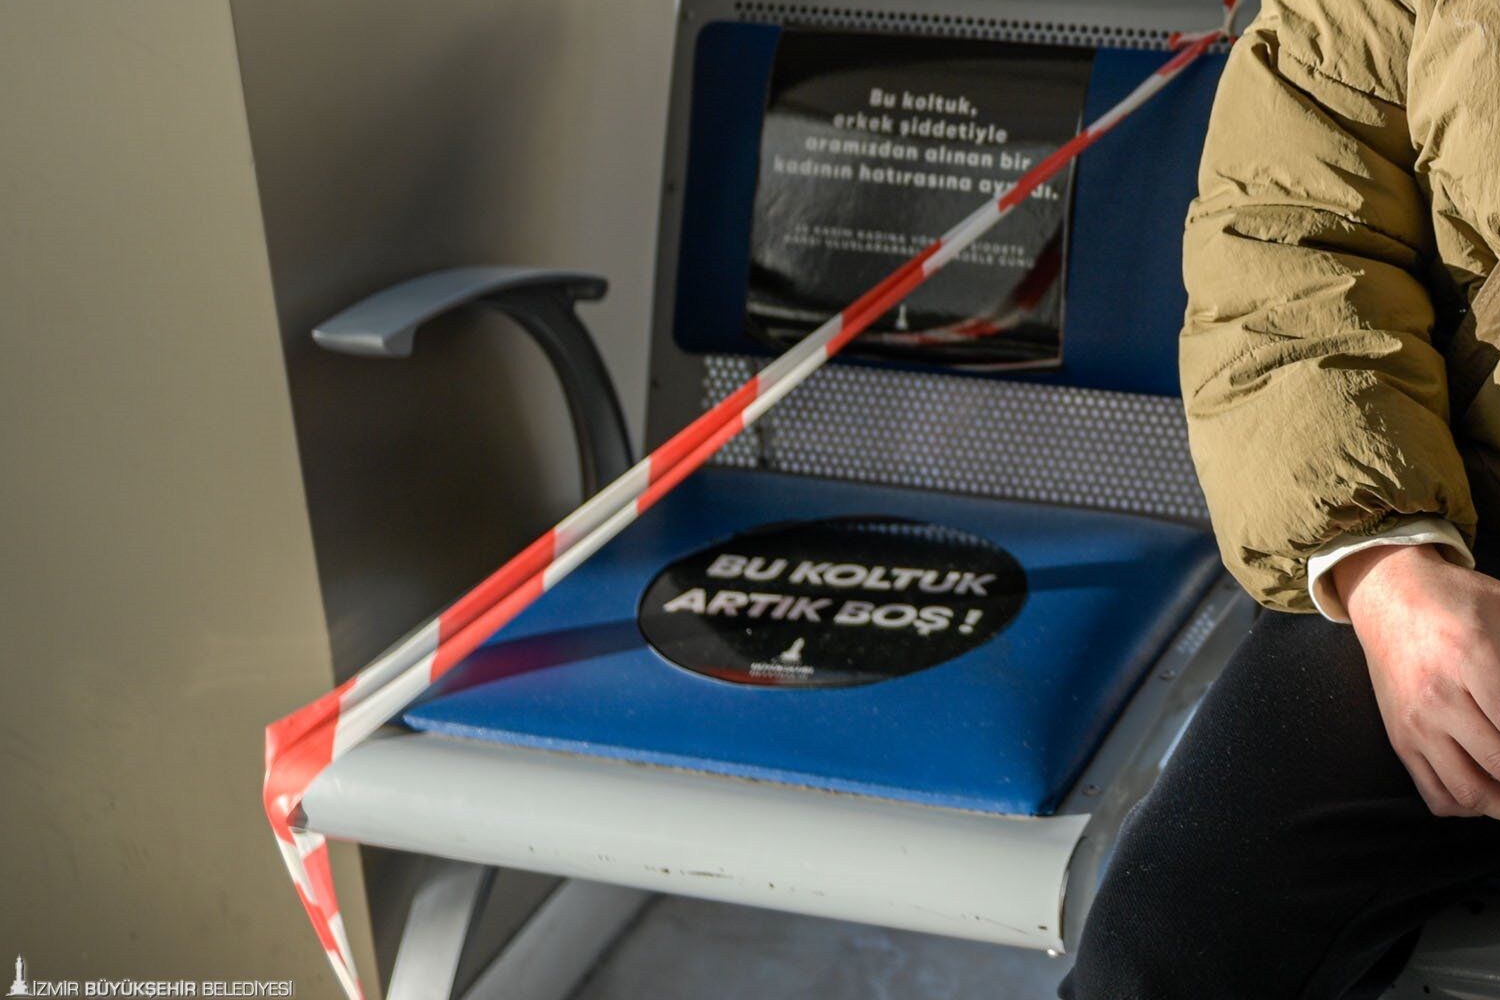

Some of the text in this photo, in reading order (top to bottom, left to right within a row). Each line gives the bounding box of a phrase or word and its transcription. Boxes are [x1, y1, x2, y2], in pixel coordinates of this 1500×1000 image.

[869, 87, 979, 117] Bu koltuk,
[833, 112, 1008, 145] erkek şiddetiyle
[924, 143, 993, 169] alınan
[999, 151, 1032, 171] bir
[705, 553, 996, 597] BU KOLTUK
[663, 587, 833, 623] ARTIK
